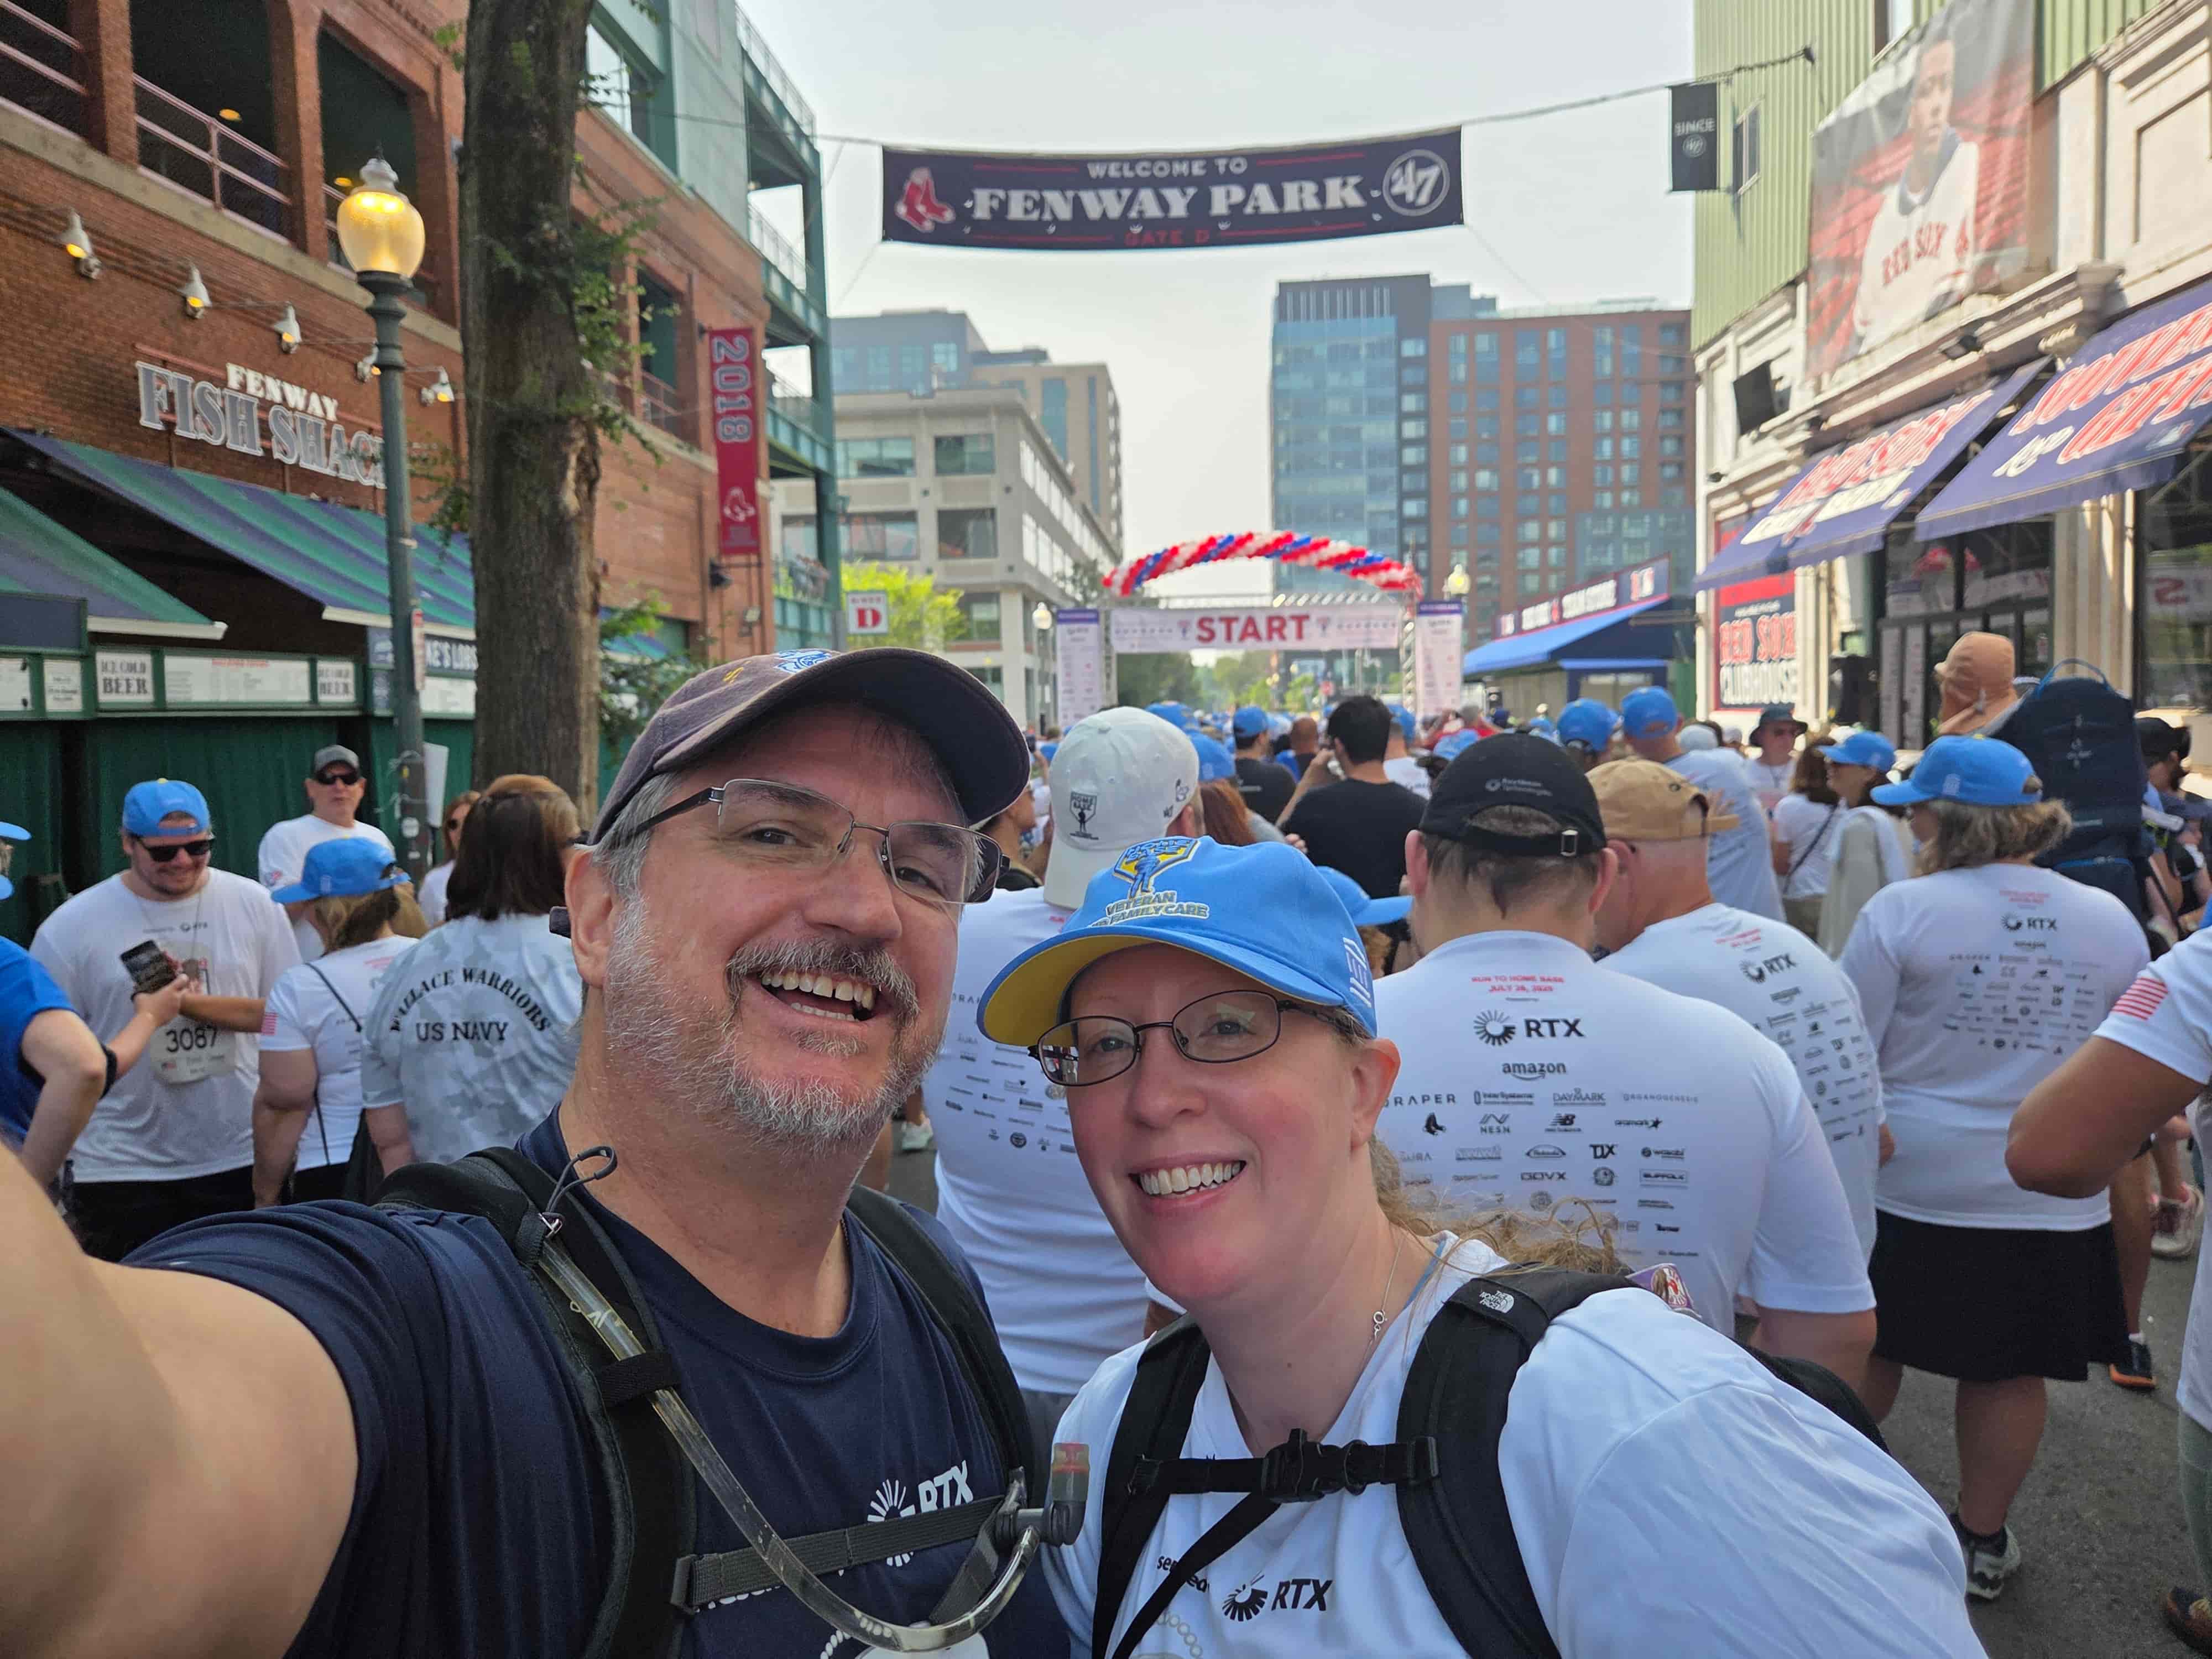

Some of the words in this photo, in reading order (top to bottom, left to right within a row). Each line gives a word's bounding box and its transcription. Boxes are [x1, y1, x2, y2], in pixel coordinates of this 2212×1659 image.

[1674, 118, 1715, 137] SINCE
[1087, 159, 1206, 179] WELCOME
[1214, 156, 1248, 174] TO
[972, 186, 1198, 221] FENWAY
[1209, 175, 1368, 216] PARK
[1125, 229, 1184, 246] GATE
[1195, 229, 1210, 244] D
[226, 362, 339, 422] FENWAY
[712, 335, 753, 443] 2018
[135, 361, 265, 457] FISH
[855, 607, 881, 628] D
[1196, 614, 1310, 644] START
[1719, 619, 1753, 666] RED
[1756, 612, 1796, 661] SOX
[102, 677, 148, 695] BEER
[1107, 892, 1176, 915] VETERAN
[1109, 905, 1164, 925] FAMILY
[1162, 904, 1211, 917] CARE
[2026, 917, 2057, 931] RTX
[1762, 953, 1797, 975] RTX
[390, 968, 456, 1032] WALLACE
[462, 966, 551, 1032] WARRIORS
[166, 1024, 218, 1053] 3087
[415, 1021, 446, 1042] US
[452, 1021, 509, 1041] NAVY
[1524, 1018, 1585, 1037] RTX
[1501, 1062, 1567, 1074] amazon
[1553, 1092, 1605, 1102] DAYMARK
[1589, 1144, 1618, 1159] TJX
[918, 1459, 973, 1513] RTX
[1271, 1578, 1333, 1611] RTX
